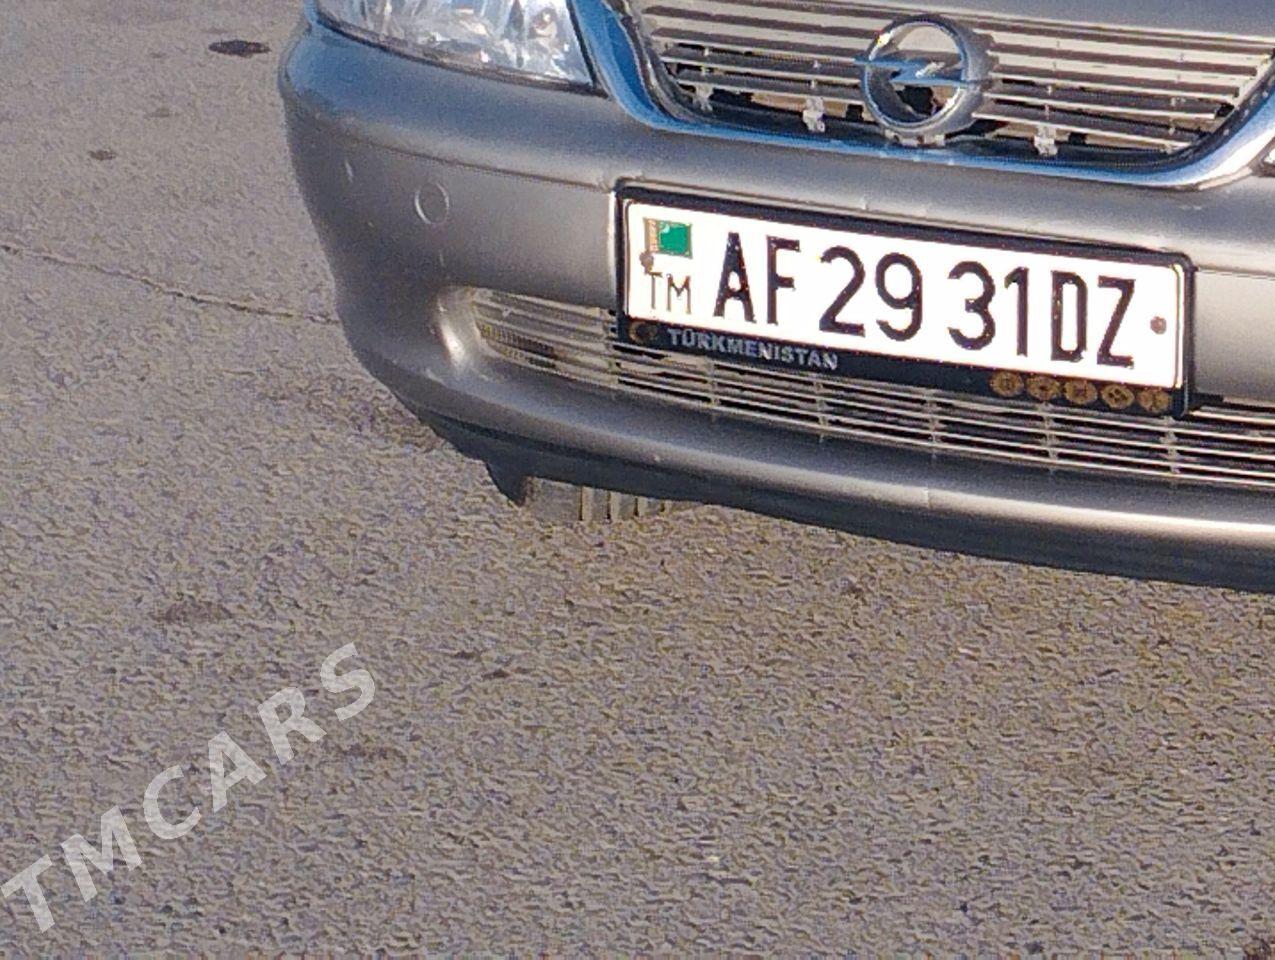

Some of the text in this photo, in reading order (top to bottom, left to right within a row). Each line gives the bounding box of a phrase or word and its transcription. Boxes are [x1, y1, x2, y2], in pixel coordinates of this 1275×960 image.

[642, 271, 692, 315] TM
[713, 231, 801, 326] AF
[819, 244, 924, 343] 29
